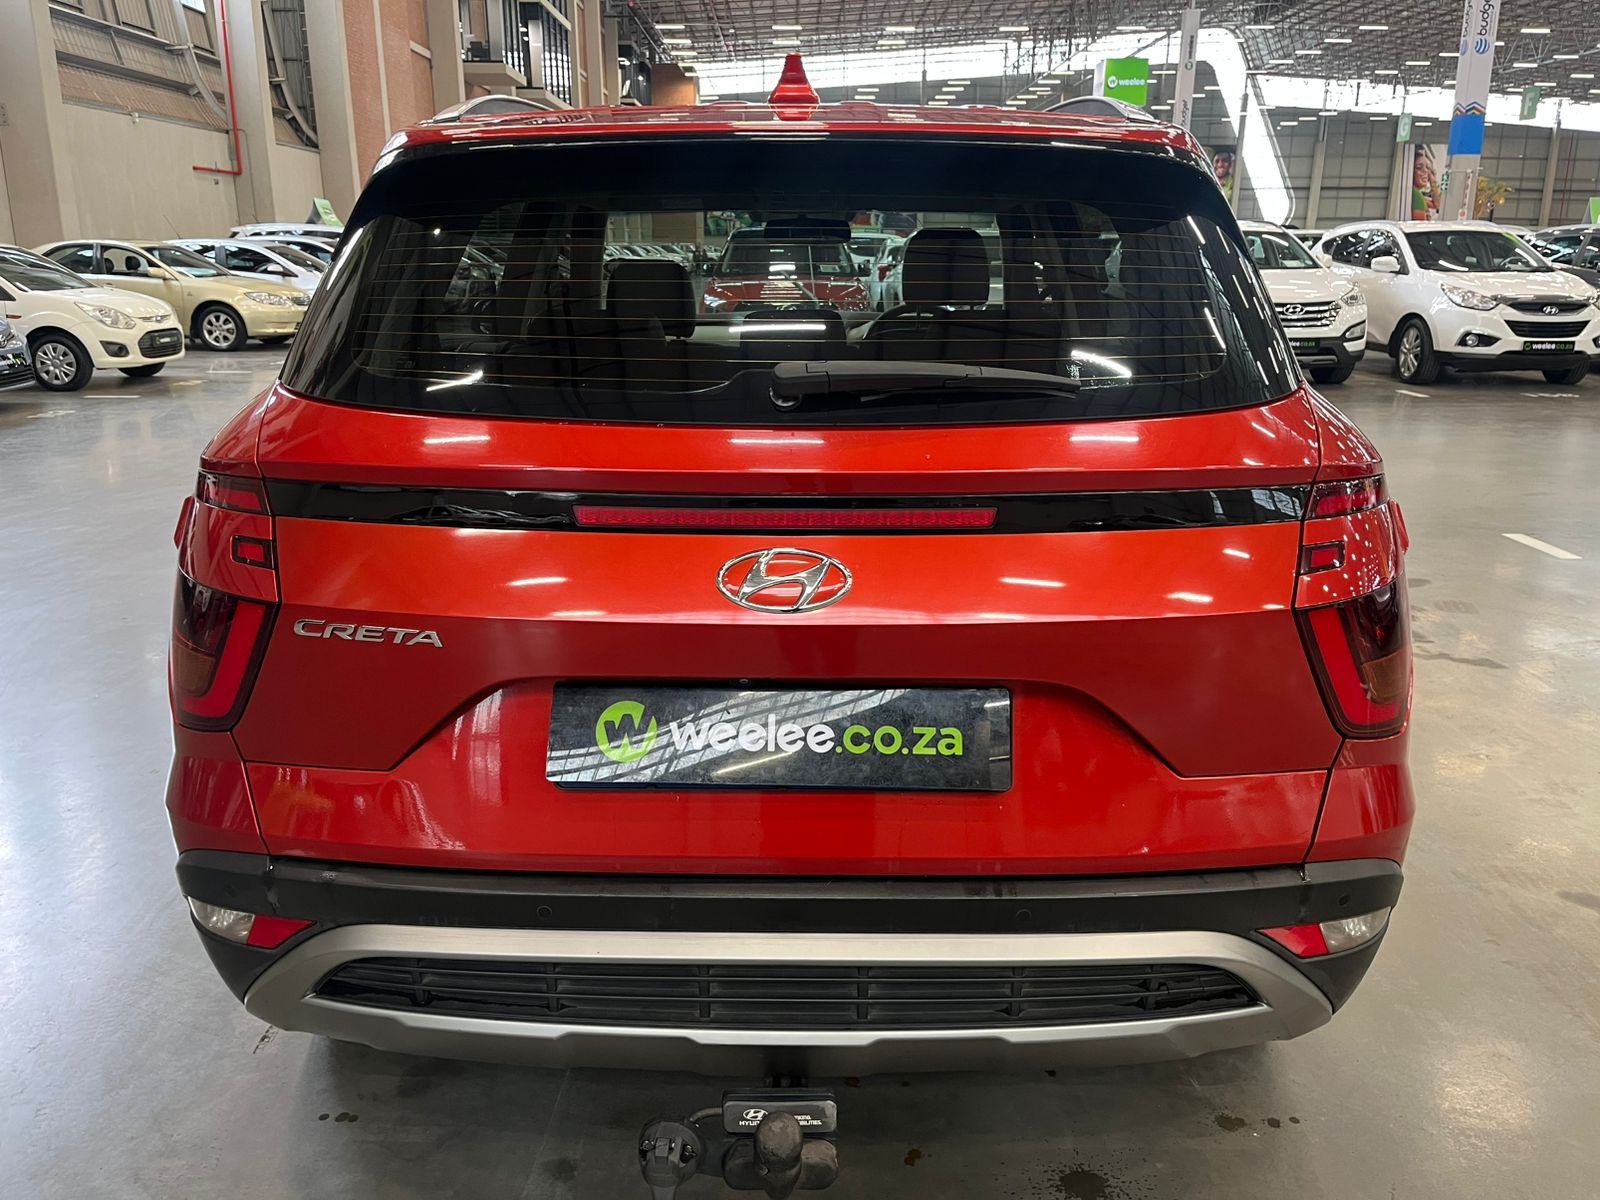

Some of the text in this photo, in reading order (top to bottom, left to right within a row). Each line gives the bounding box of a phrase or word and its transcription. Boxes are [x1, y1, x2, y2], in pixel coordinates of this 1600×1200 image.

[1477, 0, 1494, 36] budg
[293, 618, 443, 648] CRETA
[668, 713, 965, 757] weelee.co.za
